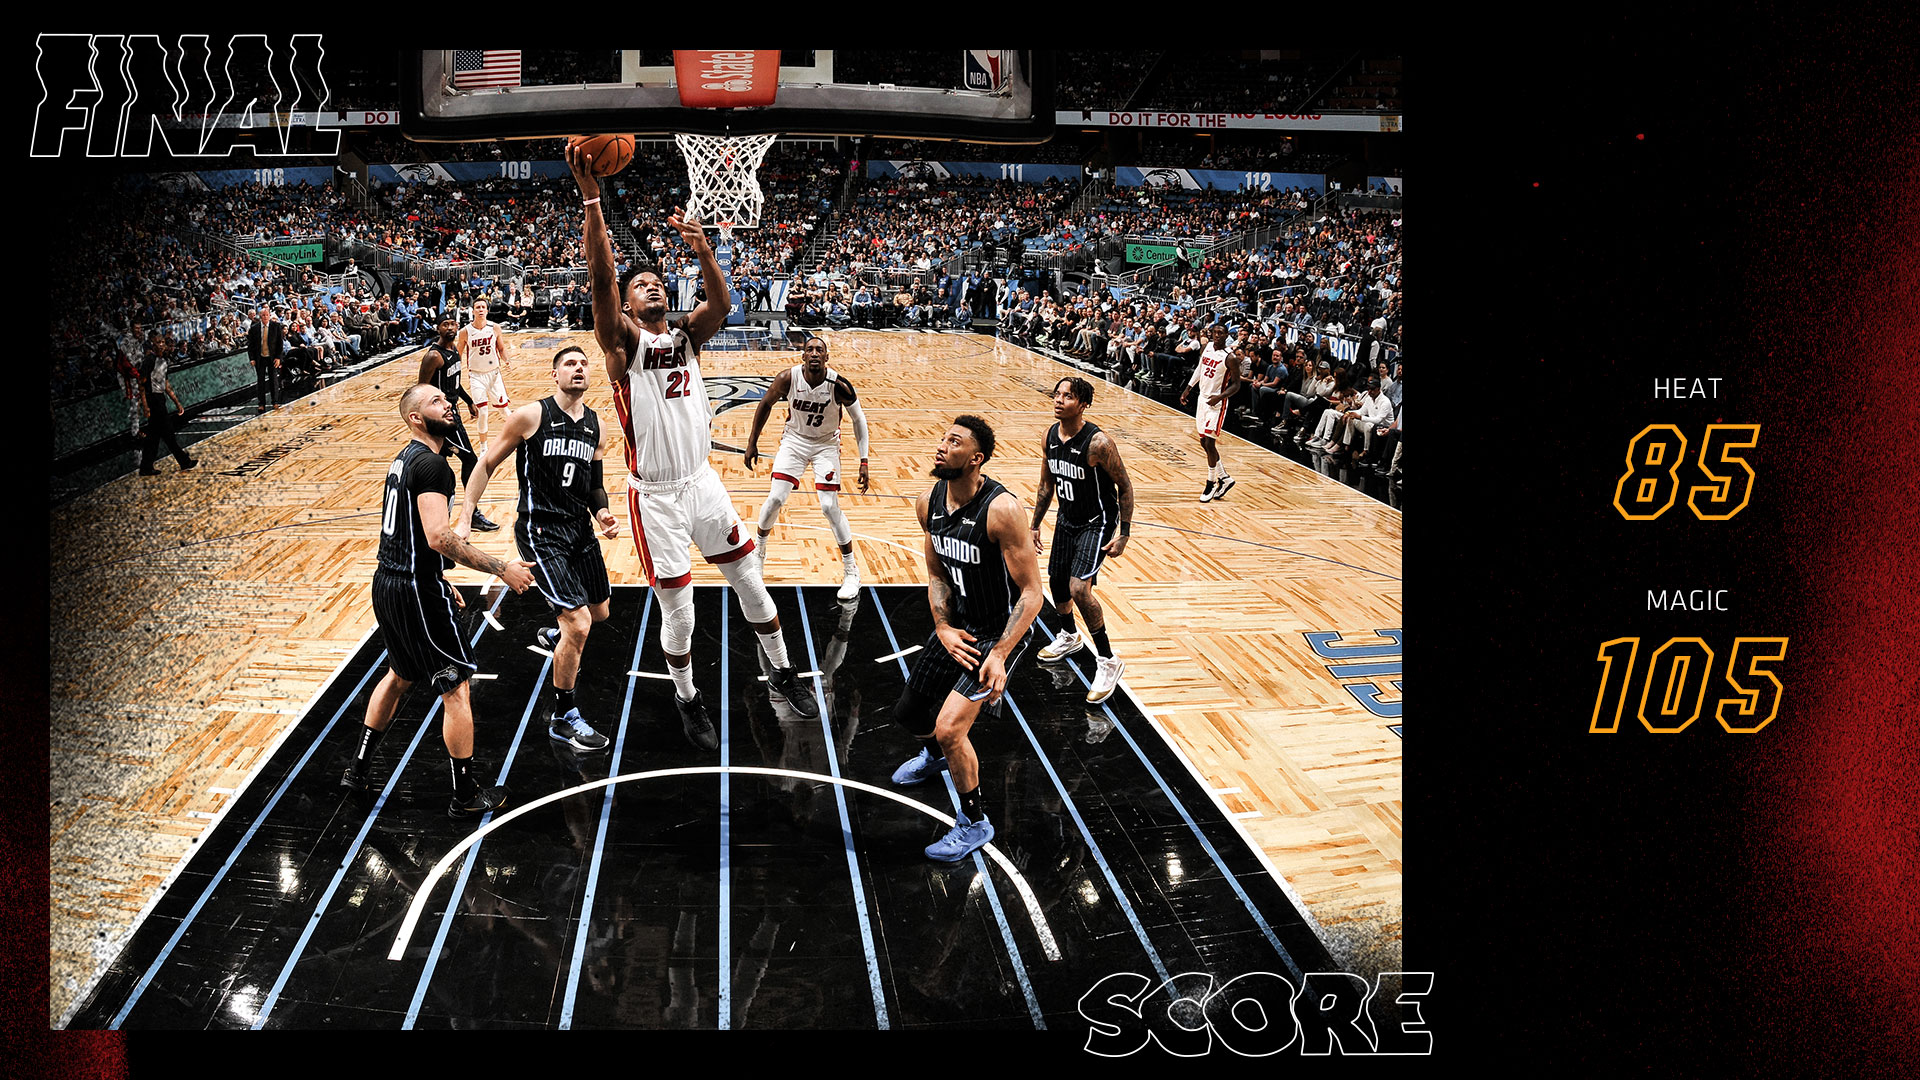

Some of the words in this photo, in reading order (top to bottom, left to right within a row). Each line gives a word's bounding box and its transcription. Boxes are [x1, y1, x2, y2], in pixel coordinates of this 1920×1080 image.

[970, 72, 987, 85] NBA
[364, 112, 389, 124] DO
[1109, 112, 1133, 125] DO
[1138, 112, 1152, 126] IT
[1157, 113, 1191, 127] FOR
[1196, 114, 1227, 127] THE
[254, 168, 285, 189] 108
[500, 161, 531, 180] 109
[1000, 163, 1023, 183] 111
[1245, 171, 1272, 192] 112
[471, 335, 494, 348] HEAT
[478, 346, 491, 356] 55
[1202, 356, 1222, 368] HEAT
[1204, 367, 1216, 379] 25
[665, 369, 691, 400] 22
[792, 398, 831, 414] HEAT
[806, 413, 825, 428] 13
[543, 438, 595, 464] ORLANDO
[561, 462, 576, 487] 9
[1056, 476, 1075, 502] 20
[930, 534, 981, 564] RLANDO
[949, 564, 967, 597] 4
